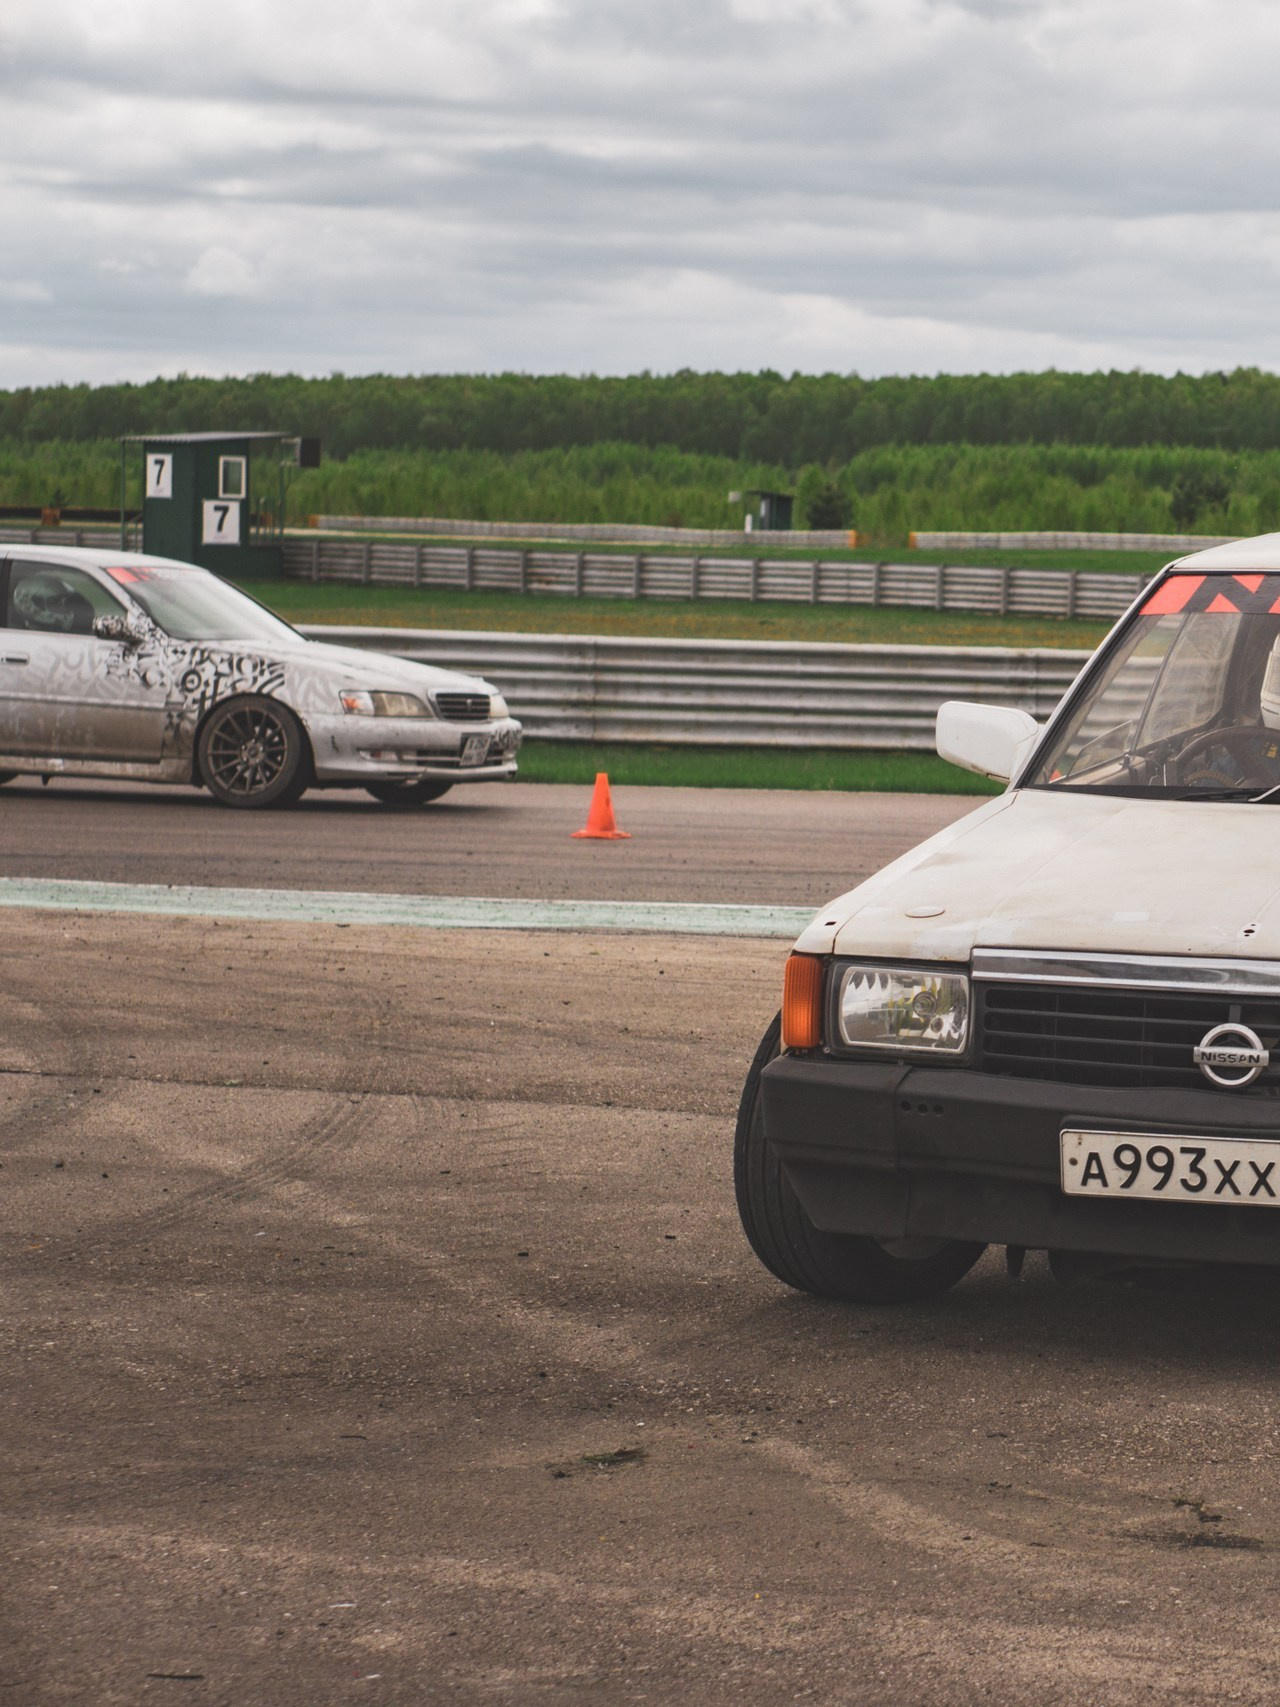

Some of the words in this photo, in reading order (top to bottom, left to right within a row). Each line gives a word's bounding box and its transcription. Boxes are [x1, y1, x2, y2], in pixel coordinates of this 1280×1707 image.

[154, 458, 165, 486] 7
[213, 505, 230, 533] 7
[1200, 1051, 1260, 1065] NISSAN
